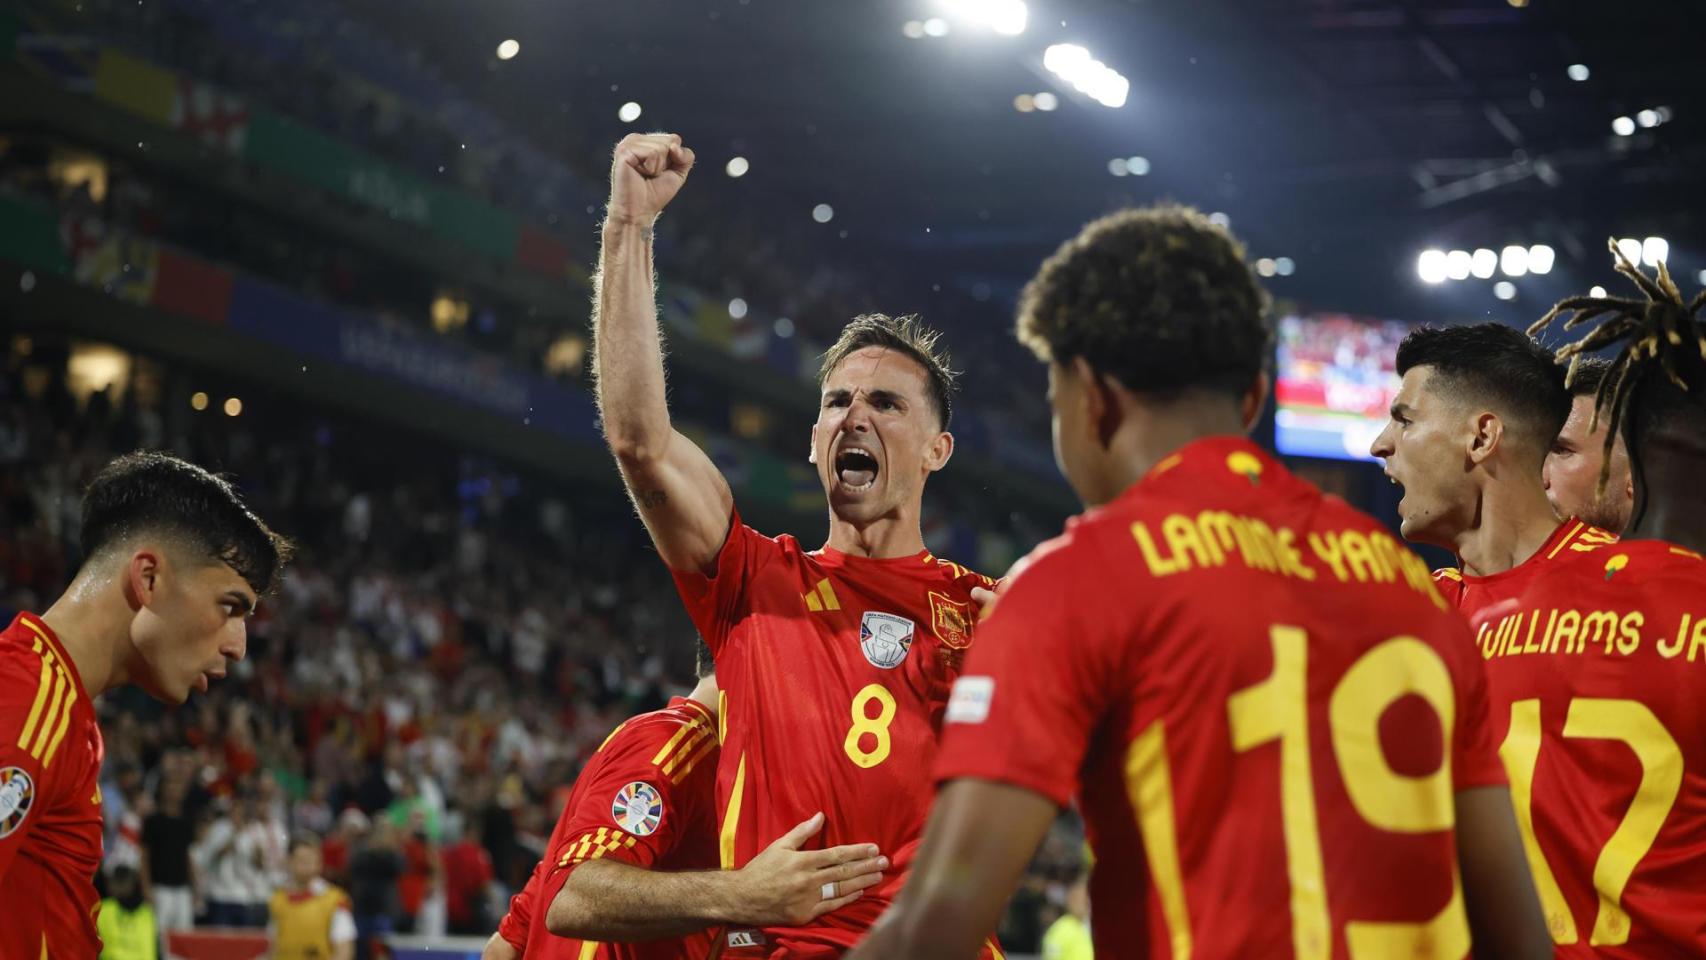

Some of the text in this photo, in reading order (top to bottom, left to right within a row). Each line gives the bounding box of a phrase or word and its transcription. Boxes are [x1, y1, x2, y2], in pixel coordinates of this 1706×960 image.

[1476, 608, 1645, 660] WILLIAMS
[844, 683, 897, 769] 8
[1228, 624, 1472, 960] 19
[1499, 698, 1684, 946] 17
